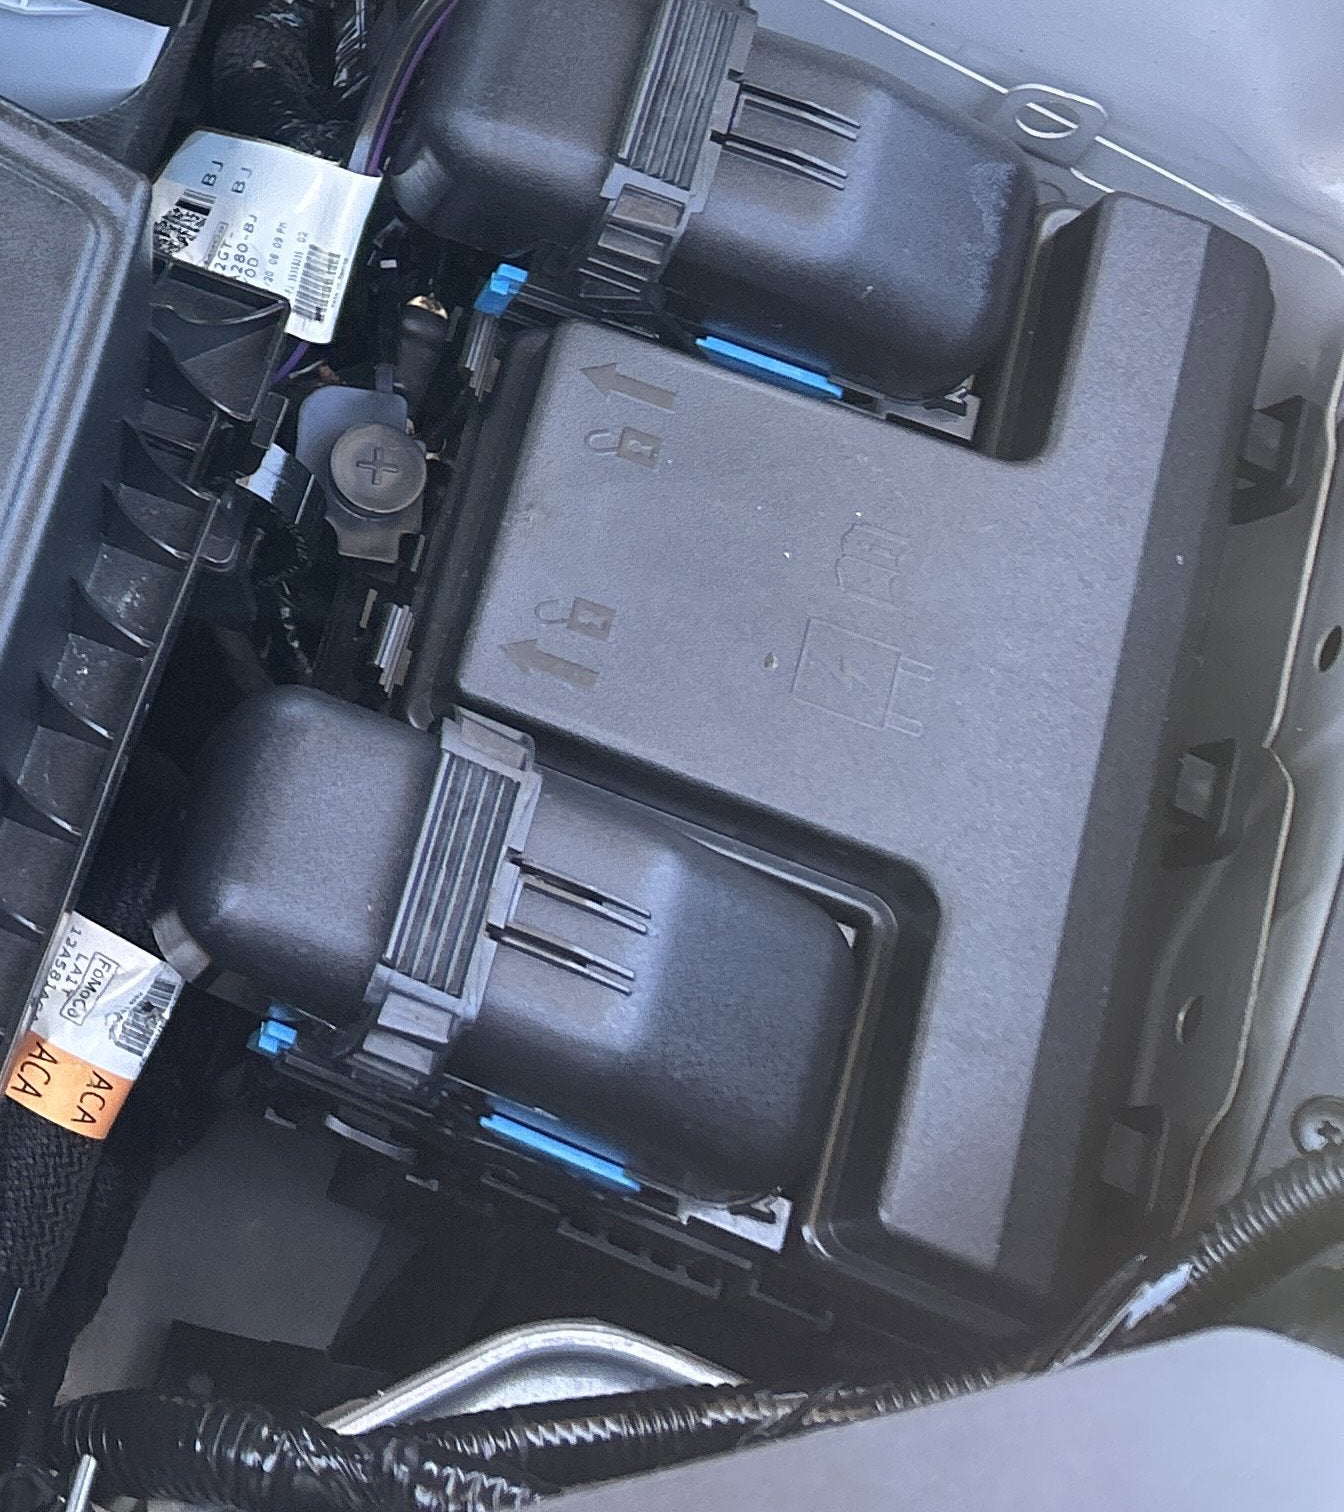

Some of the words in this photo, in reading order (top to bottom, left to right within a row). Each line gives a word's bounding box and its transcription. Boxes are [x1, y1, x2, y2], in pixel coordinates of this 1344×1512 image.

[200, 160, 224, 187] BJ
[231, 167, 253, 194] BJ
[65, 953, 112, 1025] FoMoCo
[11, 1041, 59, 1098] ACA
[71, 1070, 113, 1124] ACA
